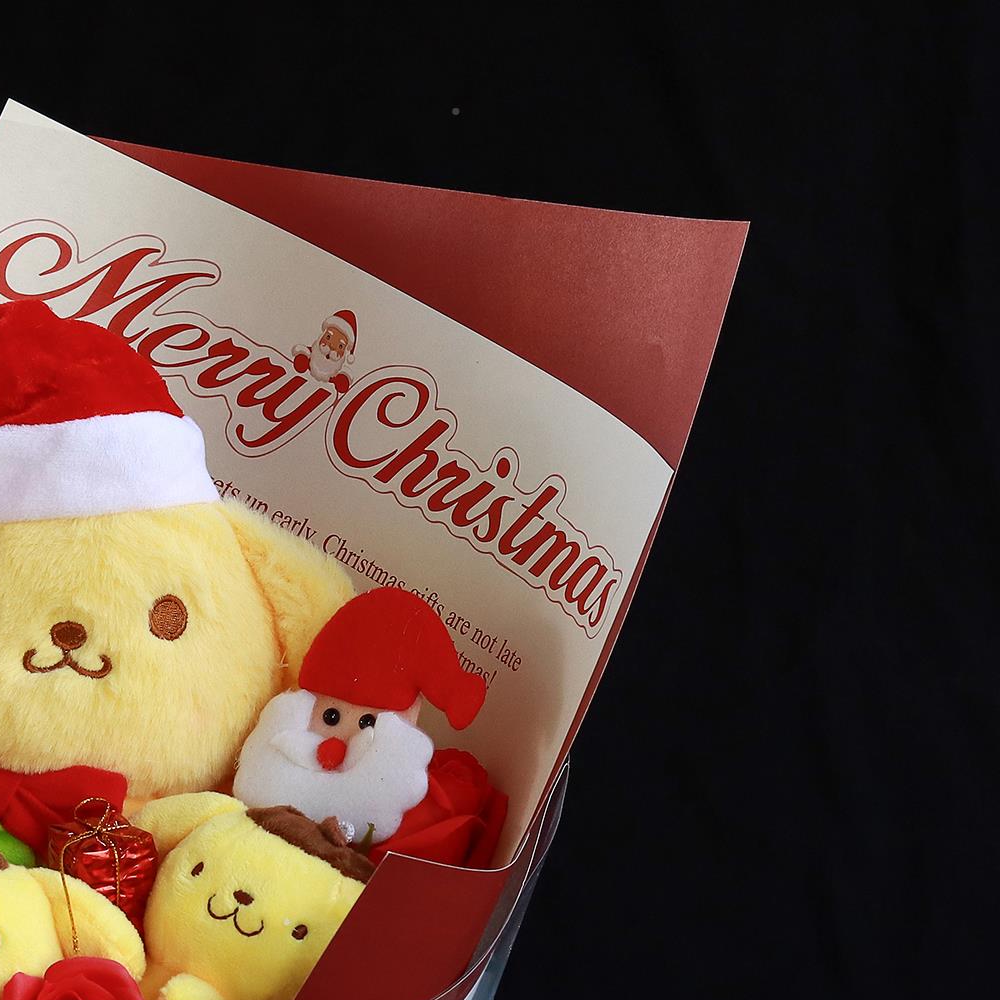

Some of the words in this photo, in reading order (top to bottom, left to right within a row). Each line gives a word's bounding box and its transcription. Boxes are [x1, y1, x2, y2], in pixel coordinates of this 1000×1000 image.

[211, 476, 241, 498] ets
[322, 534, 406, 591] Christmas
[445, 611, 471, 635] are
[470, 627, 498, 654] not
[496, 640, 522, 672] late
[332, 377, 618, 629] Christmas
